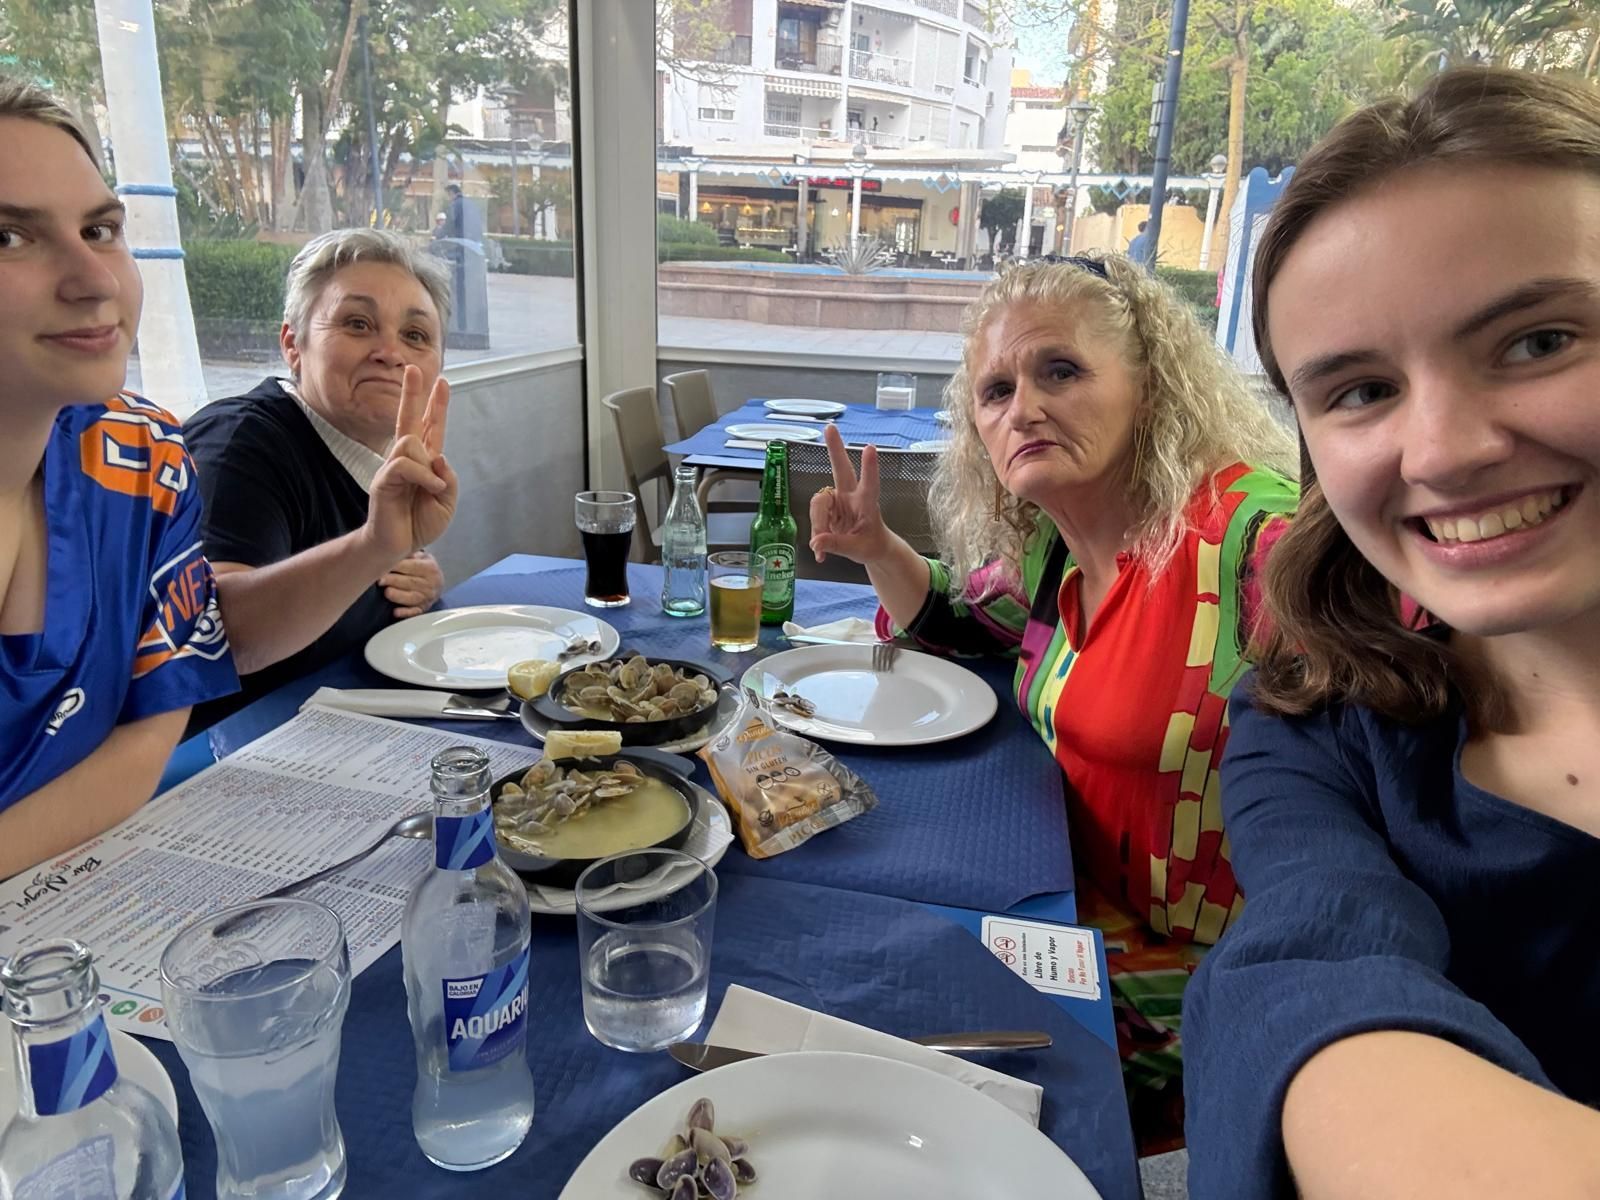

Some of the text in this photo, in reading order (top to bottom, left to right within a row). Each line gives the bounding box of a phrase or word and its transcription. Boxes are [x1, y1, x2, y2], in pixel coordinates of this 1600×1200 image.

[761, 755, 788, 770] GLUTEN
[73, 857, 102, 876] Bar
[1048, 936, 1058, 954] Vapor
[1034, 951, 1043, 979] Libre de
[1050, 961, 1058, 981] Humo
